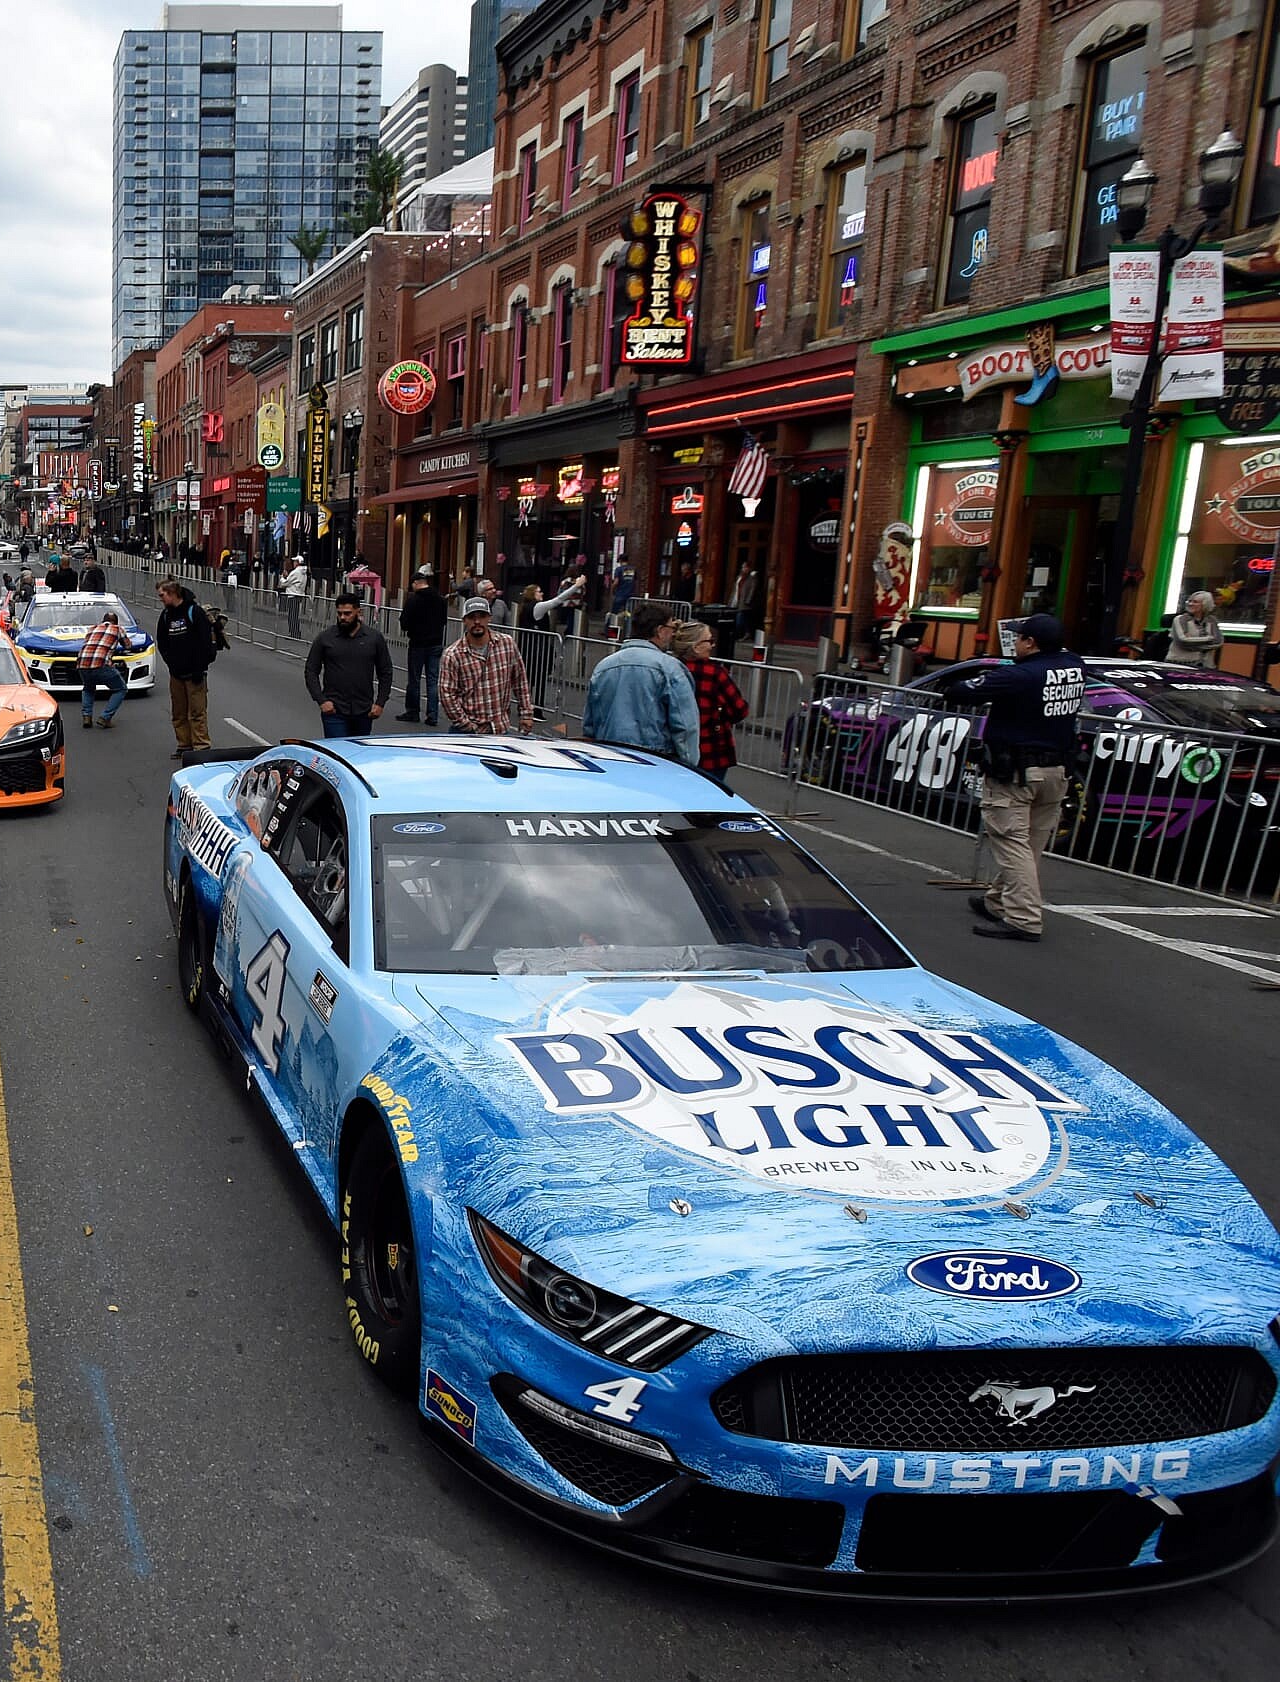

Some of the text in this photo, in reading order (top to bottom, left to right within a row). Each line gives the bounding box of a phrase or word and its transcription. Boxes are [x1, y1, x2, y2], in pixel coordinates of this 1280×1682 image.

[1102, 98, 1131, 123] BUY
[1105, 115, 1137, 142] PAIR
[1097, 184, 1117, 205] GE
[648, 201, 679, 325] WHISKEY
[625, 342, 685, 360] Saloon
[967, 341, 1111, 385] BOOT COU
[1231, 402, 1266, 421] FREE
[312, 415, 324, 502] VALENTINE
[420, 452, 471, 474] CANDY KITCHEN
[959, 511, 977, 520] YOU
[31, 659, 41, 668] 9
[1045, 667, 1084, 686] APEX
[1042, 683, 1086, 701] SECURITY
[1043, 698, 1081, 718] GROUP
[885, 713, 971, 789] 48
[1093, 731, 1204, 779] ally
[402, 822, 437, 835] Ford
[506, 818, 673, 837] HARVICK
[723, 821, 757, 832] Ford
[245, 928, 292, 1077] 4
[510, 1023, 1073, 1109] BUSCH
[362, 1073, 419, 1163] GOODYEAR
[698, 1103, 1002, 1155] LIGHT
[763, 1160, 860, 1177] BREWED
[911, 1159, 937, 1172] IN
[944, 1255, 1050, 1294] Ford
[428, 1387, 475, 1430] SUNOCO
[583, 1376, 649, 1423] 4
[825, 1449, 1192, 1490] MUSTANG
